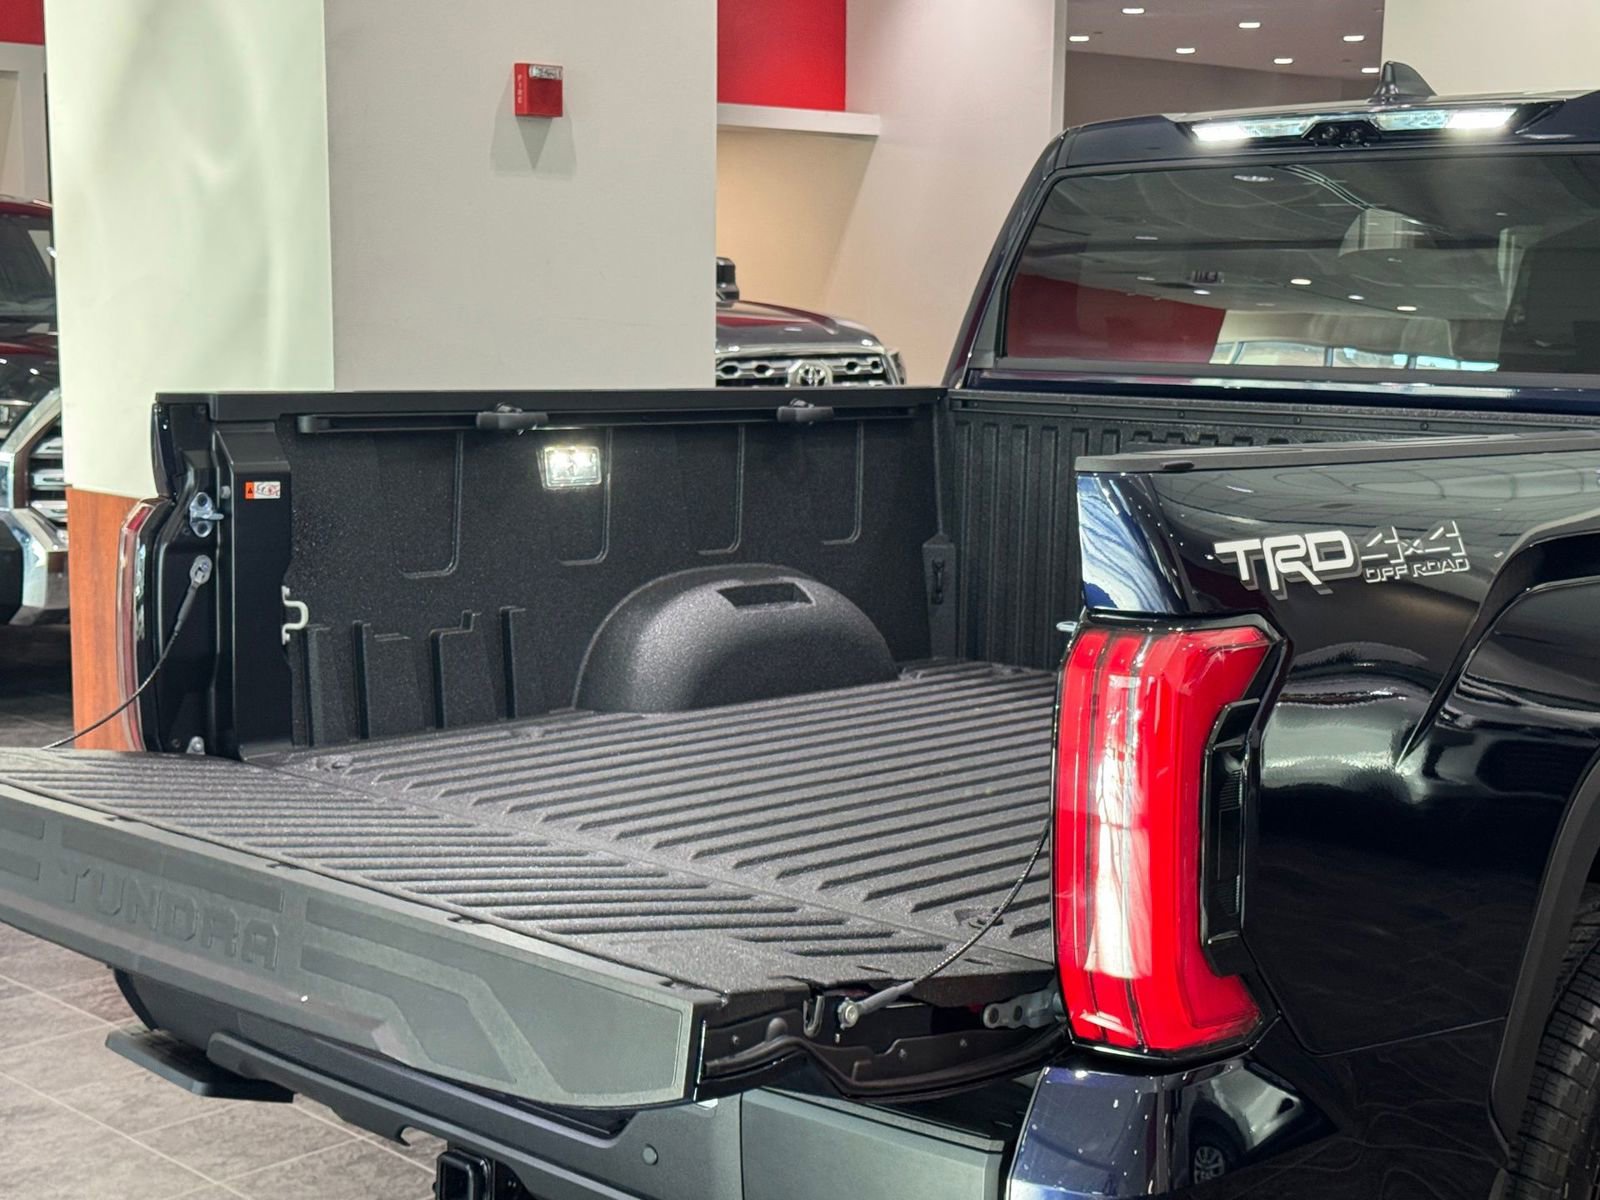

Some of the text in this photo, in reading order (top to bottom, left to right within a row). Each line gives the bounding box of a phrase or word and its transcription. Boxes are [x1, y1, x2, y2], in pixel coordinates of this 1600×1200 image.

[1213, 530, 1358, 597] TRD
[1364, 557, 1471, 584] OFF ROAD
[60, 857, 279, 971] TUNDRA
